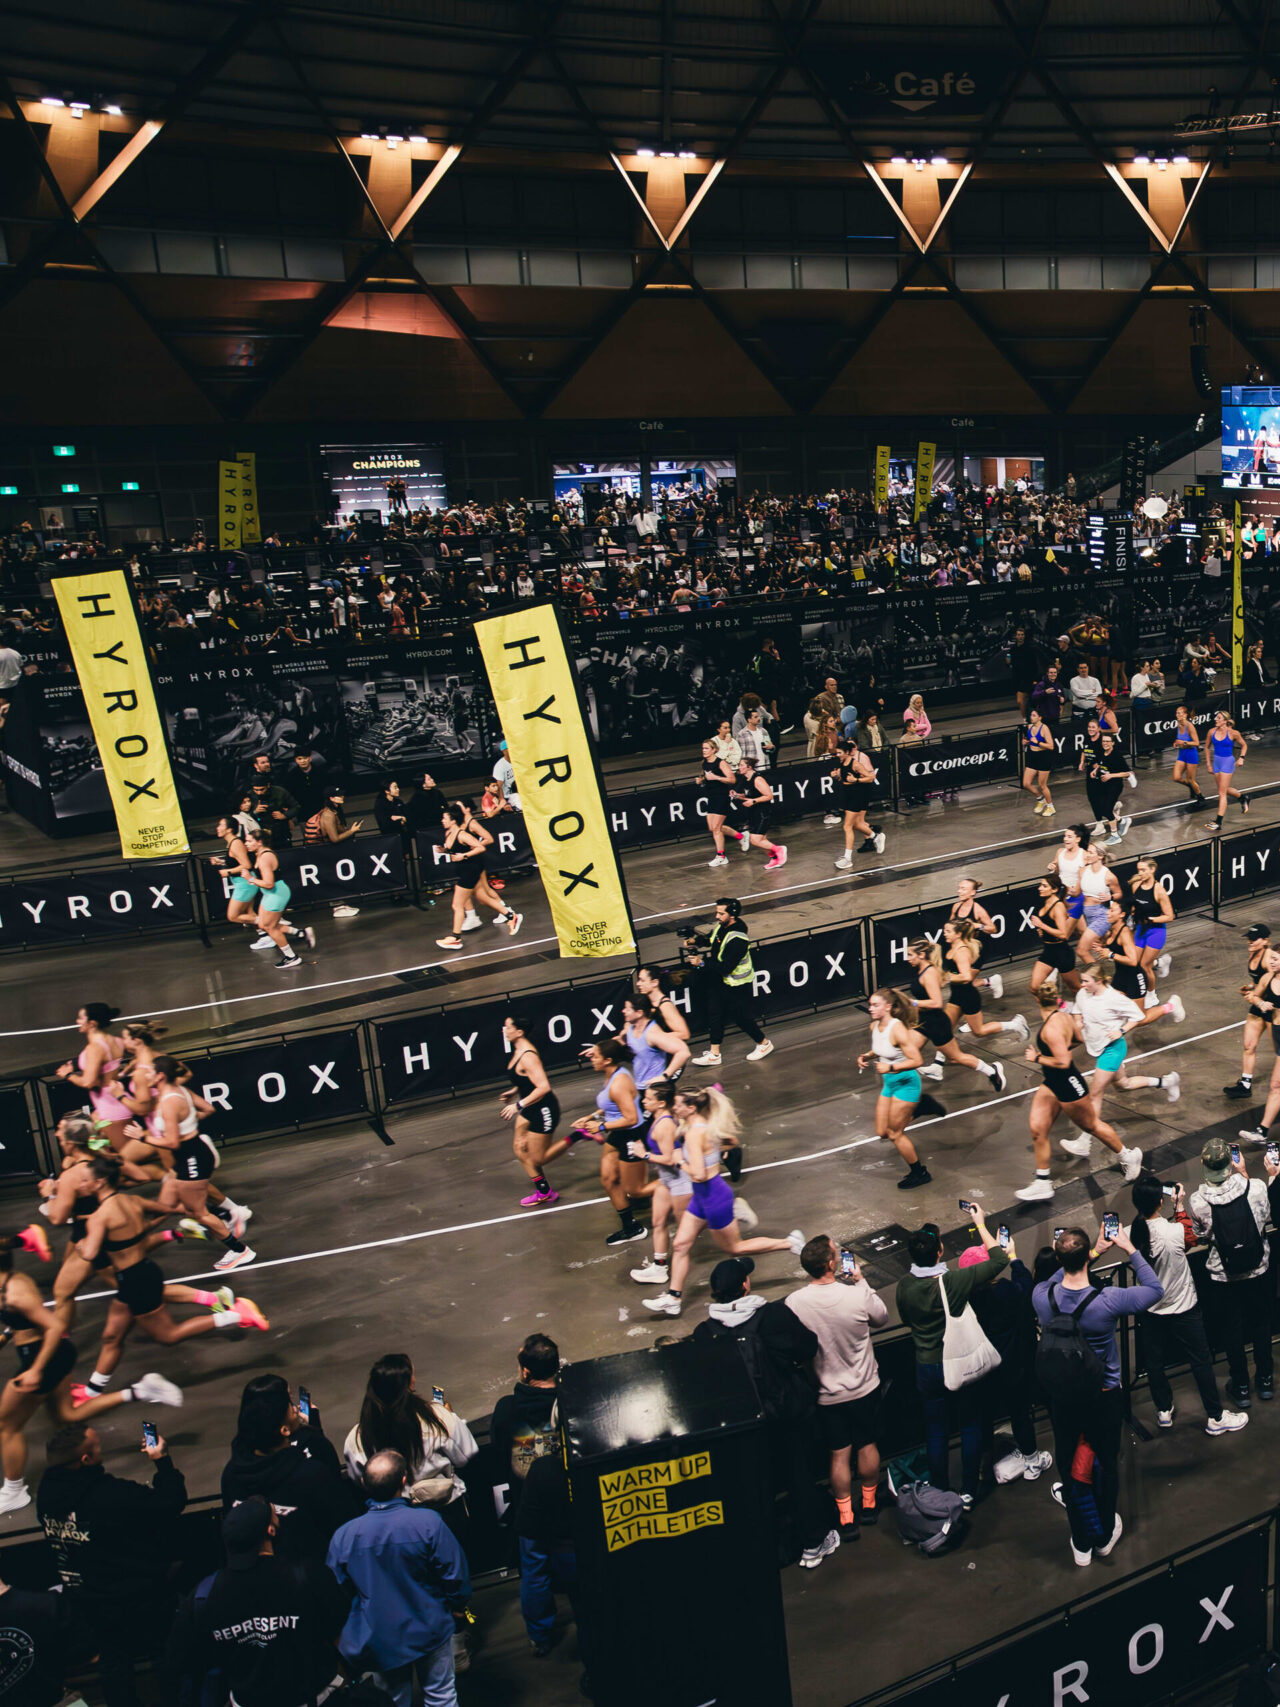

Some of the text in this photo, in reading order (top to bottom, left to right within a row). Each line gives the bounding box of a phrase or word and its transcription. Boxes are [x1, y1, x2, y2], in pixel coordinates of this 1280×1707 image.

[893, 70, 975, 97] Café
[639, 421, 664, 430] Café
[951, 418, 975, 427] Café
[352, 459, 421, 470] CHAMPIONS
[918, 447, 931, 508] HYROX
[241, 458, 257, 526] HYROX
[224, 468, 237, 548] HYROX
[1052, 582, 1087, 592] HYROX
[886, 599, 925, 609] HYROX
[644, 624, 685, 634] HYROX.COM
[696, 619, 741, 630] HYROX
[406, 648, 453, 659] HYROX.COM
[189, 667, 254, 682] HYROX
[77, 593, 160, 803] HYROX
[1163, 713, 1212, 731] coept
[503, 635, 600, 895] HYROX
[932, 747, 1008, 776] concept 2
[138, 825, 165, 836] NEVER
[142, 833, 164, 843] STOP
[130, 838, 178, 850] COMPETING
[223, 853, 391, 899] HROX
[0, 884, 174, 929] YROX
[575, 921, 607, 934] NEVER
[581, 929, 606, 940] STOP
[569, 936, 622, 950] COMPETING
[669, 951, 846, 1014] HROX
[601, 1456, 709, 1496] WARM UP
[605, 1492, 665, 1523] ZONE
[609, 1505, 722, 1547] ATHLETES
[213, 1615, 299, 1642] REPRESENT
[1000, 1584, 1235, 1707] ROX
